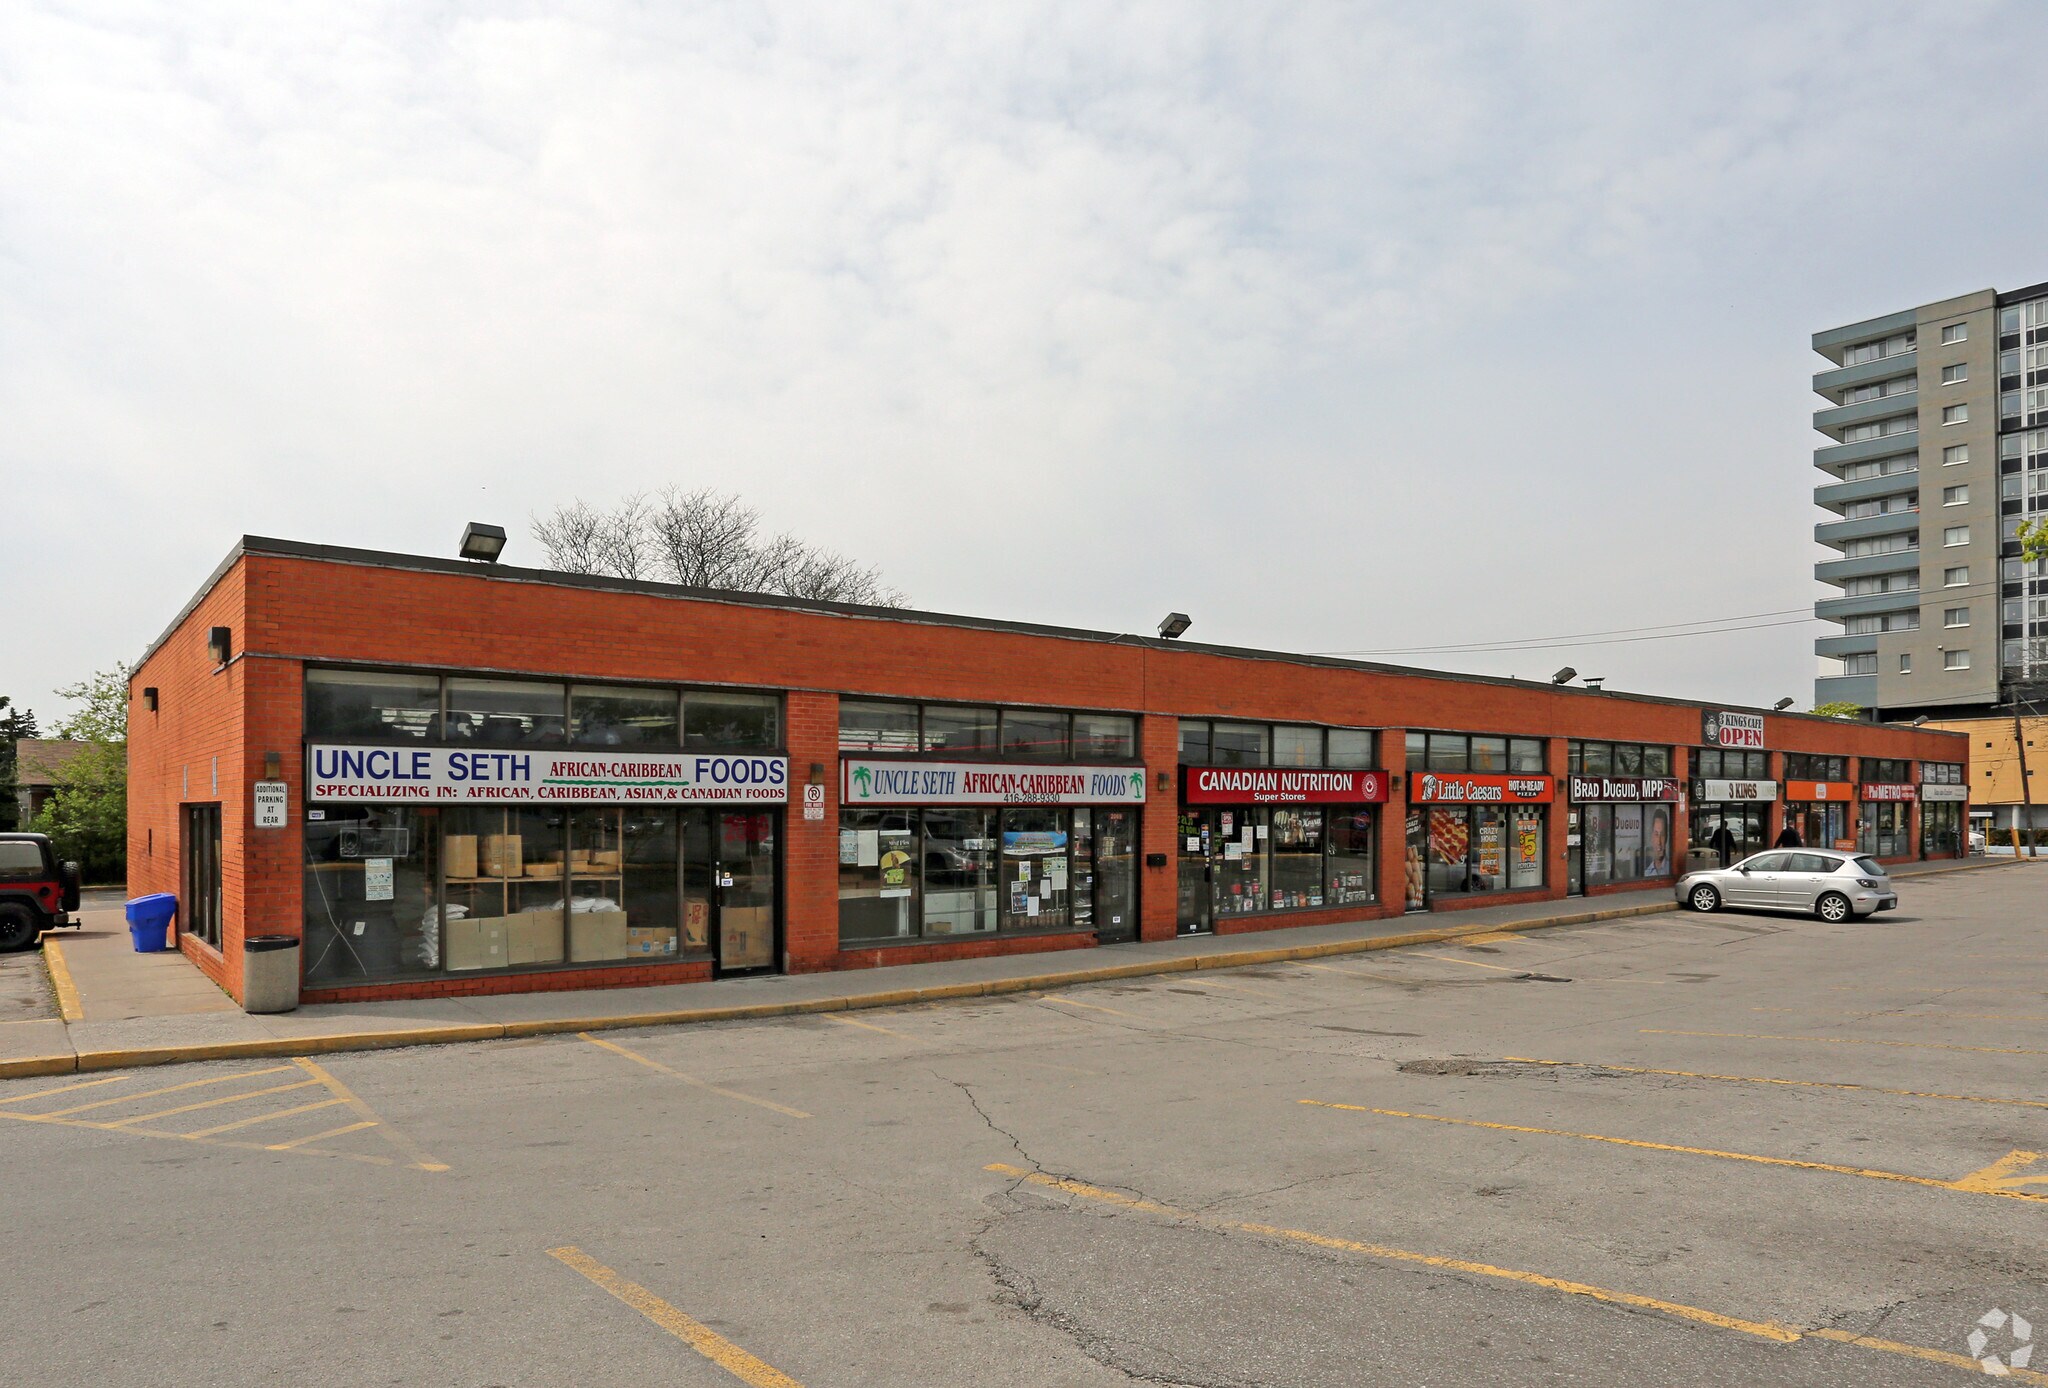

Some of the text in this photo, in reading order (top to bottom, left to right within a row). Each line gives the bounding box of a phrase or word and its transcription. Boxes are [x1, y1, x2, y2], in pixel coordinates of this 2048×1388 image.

[1719, 714, 1725, 725] 3
[1726, 714, 1747, 728] KINGS
[1720, 727, 1762, 746] OPEN
[316, 749, 530, 781] UNCLE SETH
[549, 761, 682, 778] AFRICAN-CARIBBEAN
[695, 758, 785, 784] FOODS
[256, 785, 285, 794] ADDITIONAL
[874, 769, 956, 795] UNCLE SETH
[962, 771, 1085, 794] AFRICAN-CARIBBEAN
[1090, 774, 1127, 796] FOODS
[1199, 771, 1353, 791] CANADIAN NUTRITION
[1508, 780, 1545, 791] HOT-N-READY
[1642, 779, 1664, 798] MPP
[315, 784, 430, 797] SPECIALIZING
[436, 785, 458, 797] IN:
[466, 786, 534, 799] AFRICAN,
[538, 787, 621, 800] CARIBBEAN,
[681, 788, 742, 799] CANADIAN
[746, 788, 785, 799] FOODS
[1003, 793, 1060, 803] 416-288-9330
[1254, 792, 1306, 802] Super Stores
[1438, 780, 1502, 800] Little Caesars
[1735, 782, 1758, 799] KINGS
[257, 795, 284, 803] PARKING
[262, 816, 279, 824] REAR
[1479, 827, 1499, 835] CRAZY
